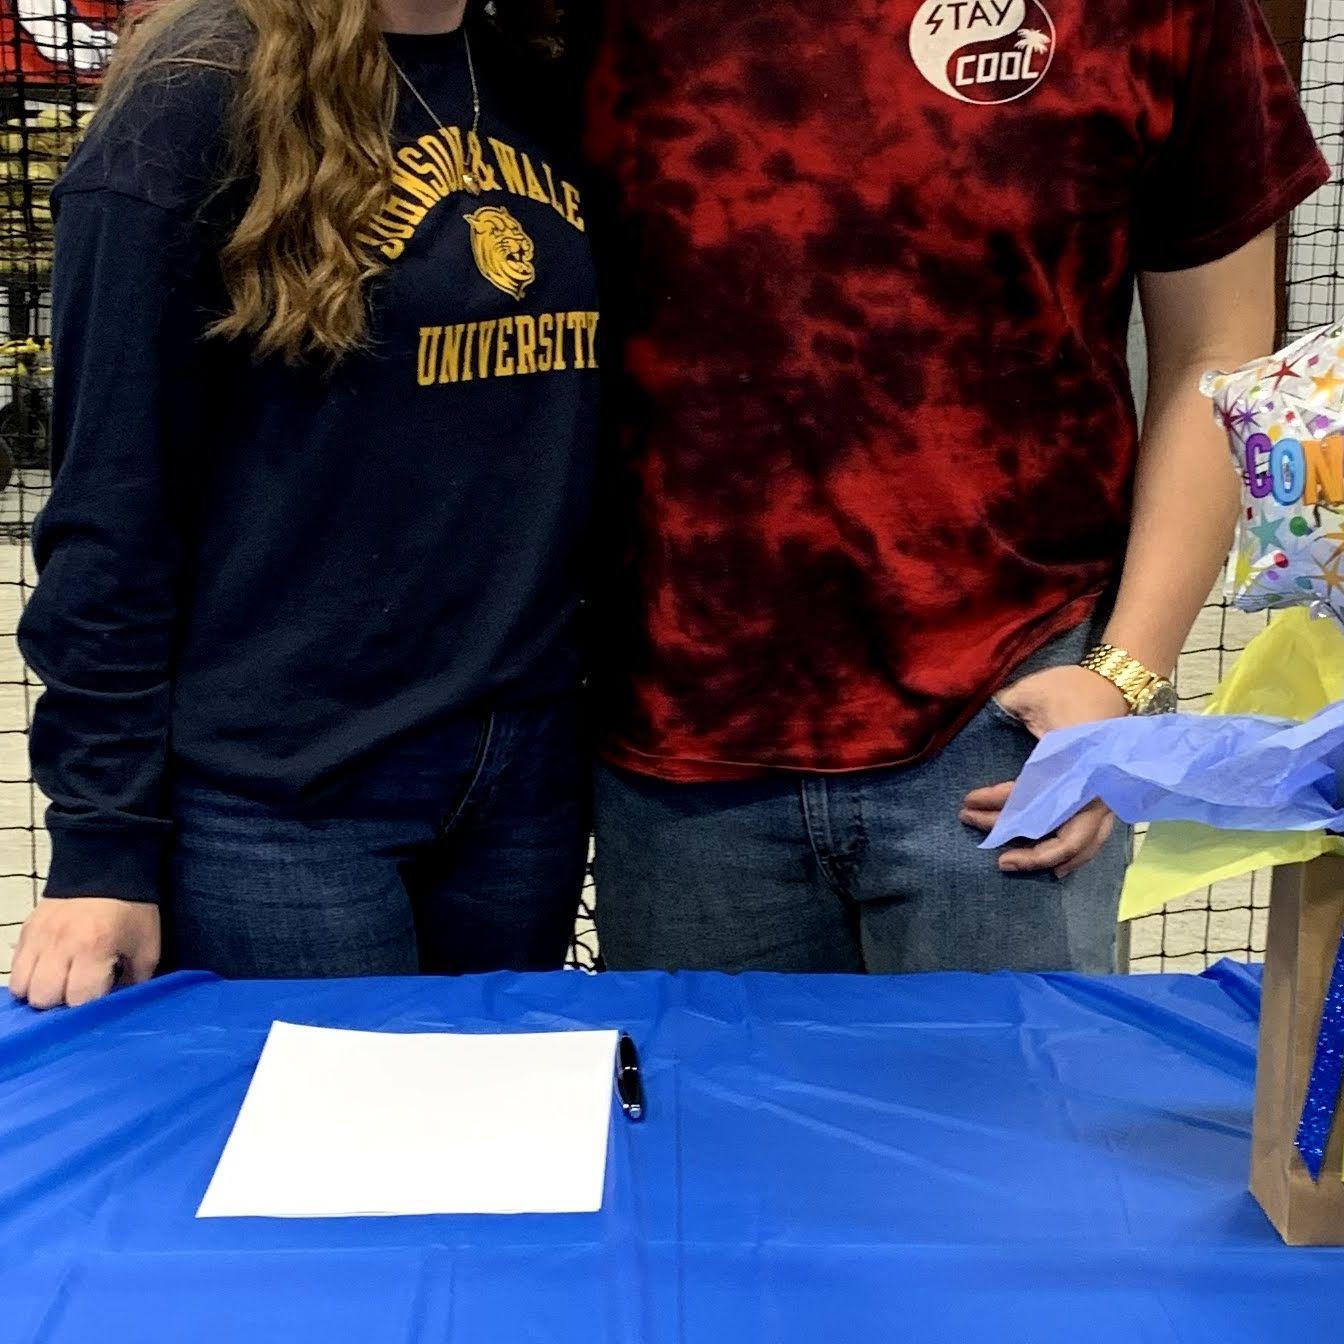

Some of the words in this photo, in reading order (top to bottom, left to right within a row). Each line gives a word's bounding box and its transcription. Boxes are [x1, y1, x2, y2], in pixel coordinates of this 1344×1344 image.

[955, 44, 1040, 87] COOL
[355, 126, 465, 260] JOHNSON
[466, 130, 503, 192] &
[487, 136, 586, 233] WALE
[417, 311, 601, 387] UNIVERSITY
